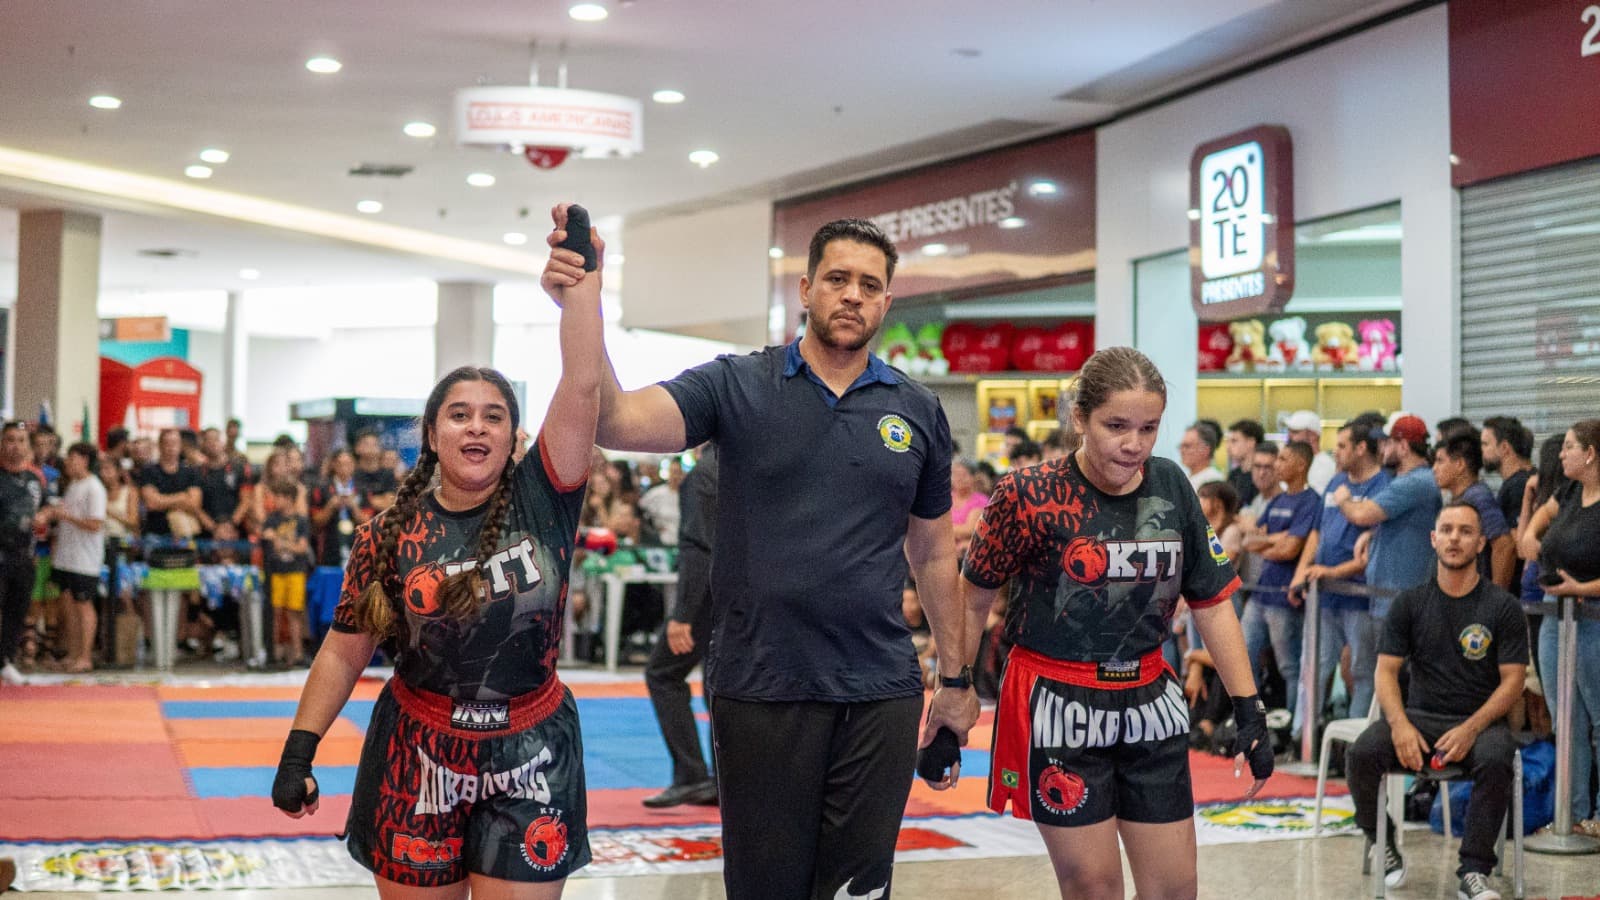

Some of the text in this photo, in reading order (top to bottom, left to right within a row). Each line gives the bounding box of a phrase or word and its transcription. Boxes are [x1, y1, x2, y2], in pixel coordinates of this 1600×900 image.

[1106, 541, 1181, 578] KTT
[1033, 678, 1190, 749] KICKBOXIN
[540, 807, 563, 816] KTT
